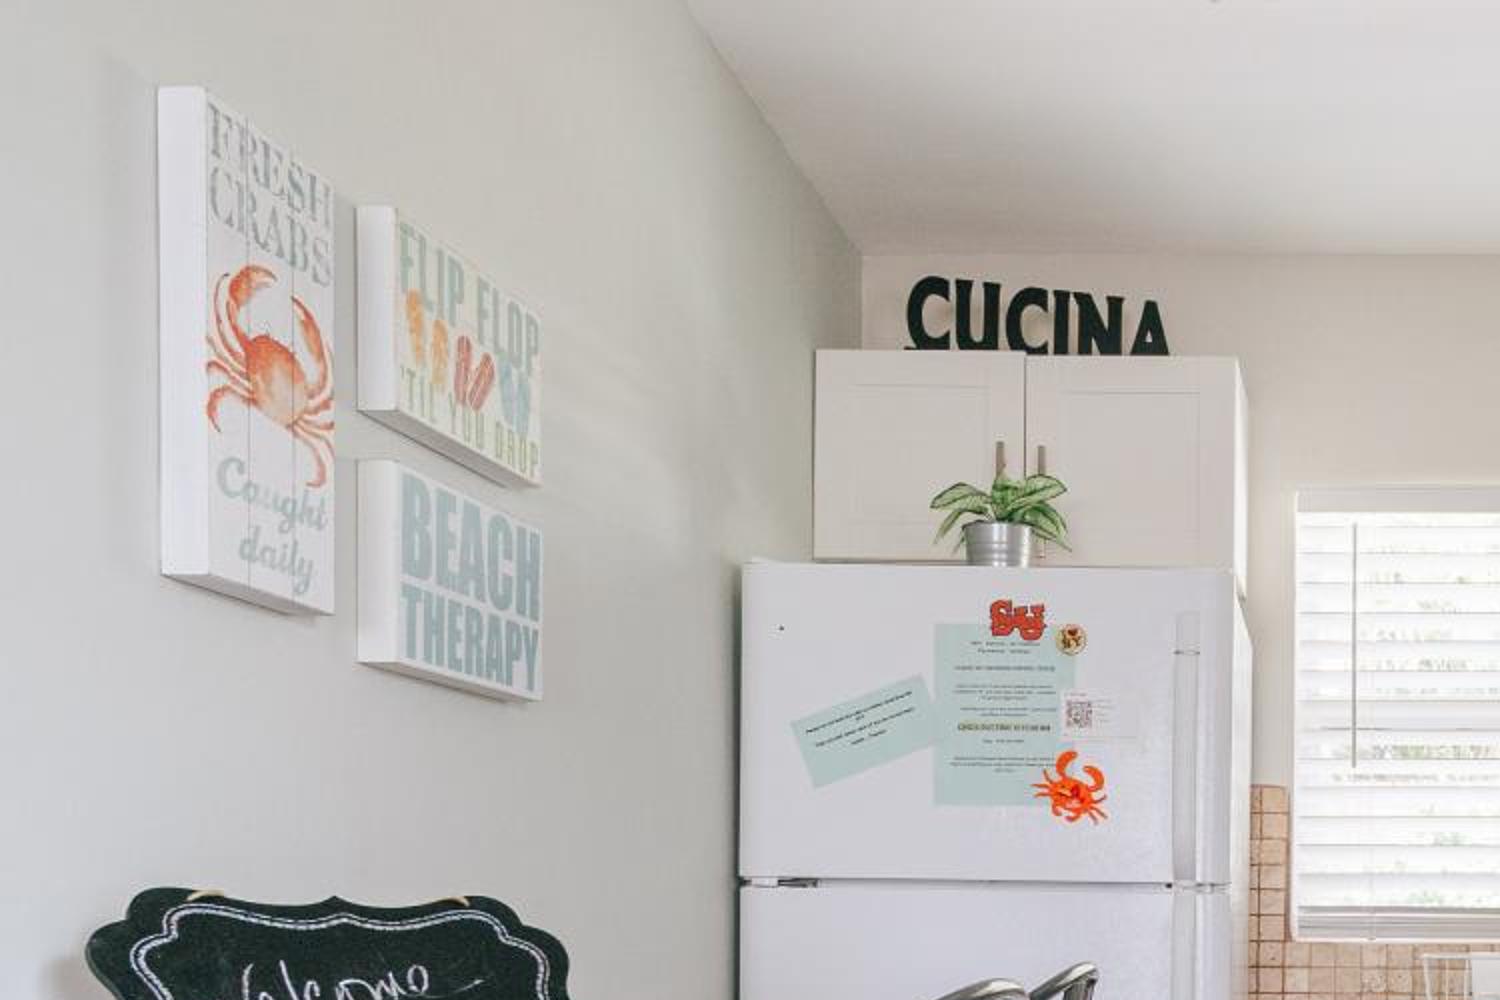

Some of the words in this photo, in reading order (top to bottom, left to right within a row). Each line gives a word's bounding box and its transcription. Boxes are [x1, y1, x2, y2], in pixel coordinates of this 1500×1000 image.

[208, 102, 333, 232] FRESH
[208, 165, 331, 287] CRABS
[400, 221, 464, 327] FLIP
[477, 274, 539, 378] FLOP
[904, 275, 1169, 356] CUCINA
[216, 456, 329, 535] Caught
[495, 419, 539, 478] DROP
[238, 524, 314, 596] daily
[401, 472, 540, 622] BEACH
[401, 580, 540, 693] THERAPY
